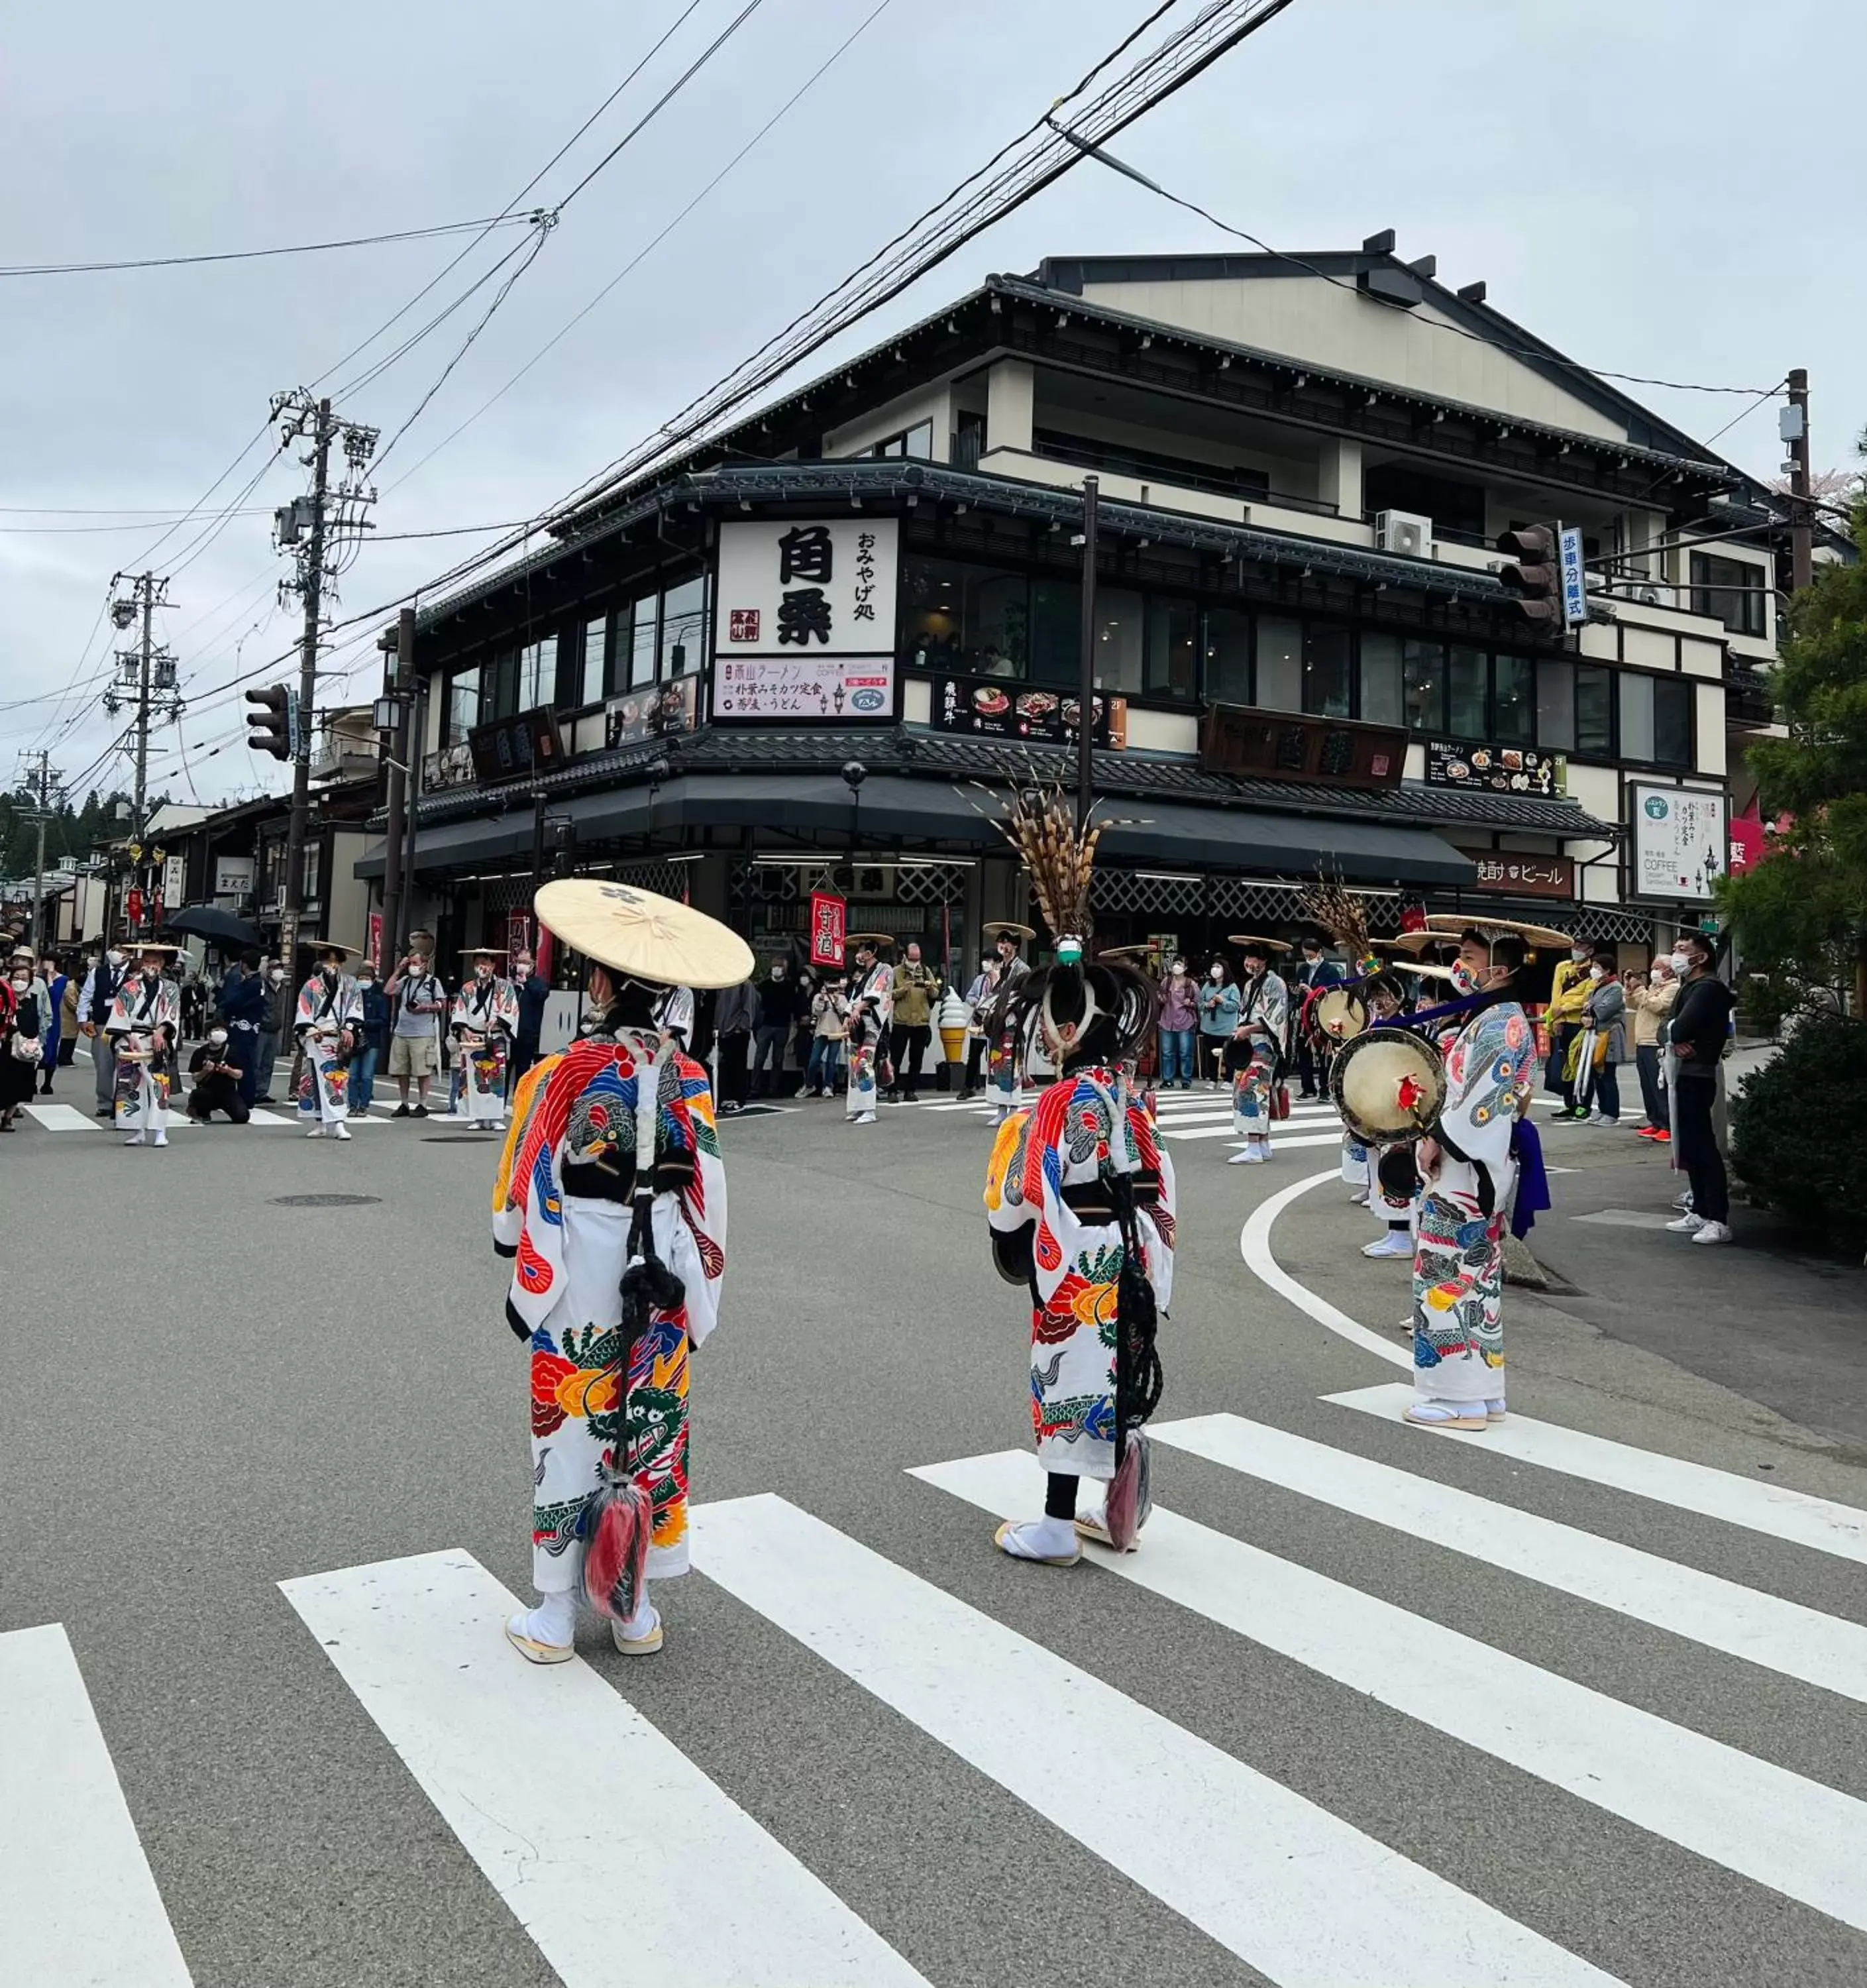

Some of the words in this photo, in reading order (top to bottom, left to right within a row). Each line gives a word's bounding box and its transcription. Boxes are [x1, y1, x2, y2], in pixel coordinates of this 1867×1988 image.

[854, 533, 876, 620] おみやげ処
[1564, 535, 1581, 614] 歩車分離式
[1522, 865, 1563, 885] ビール
